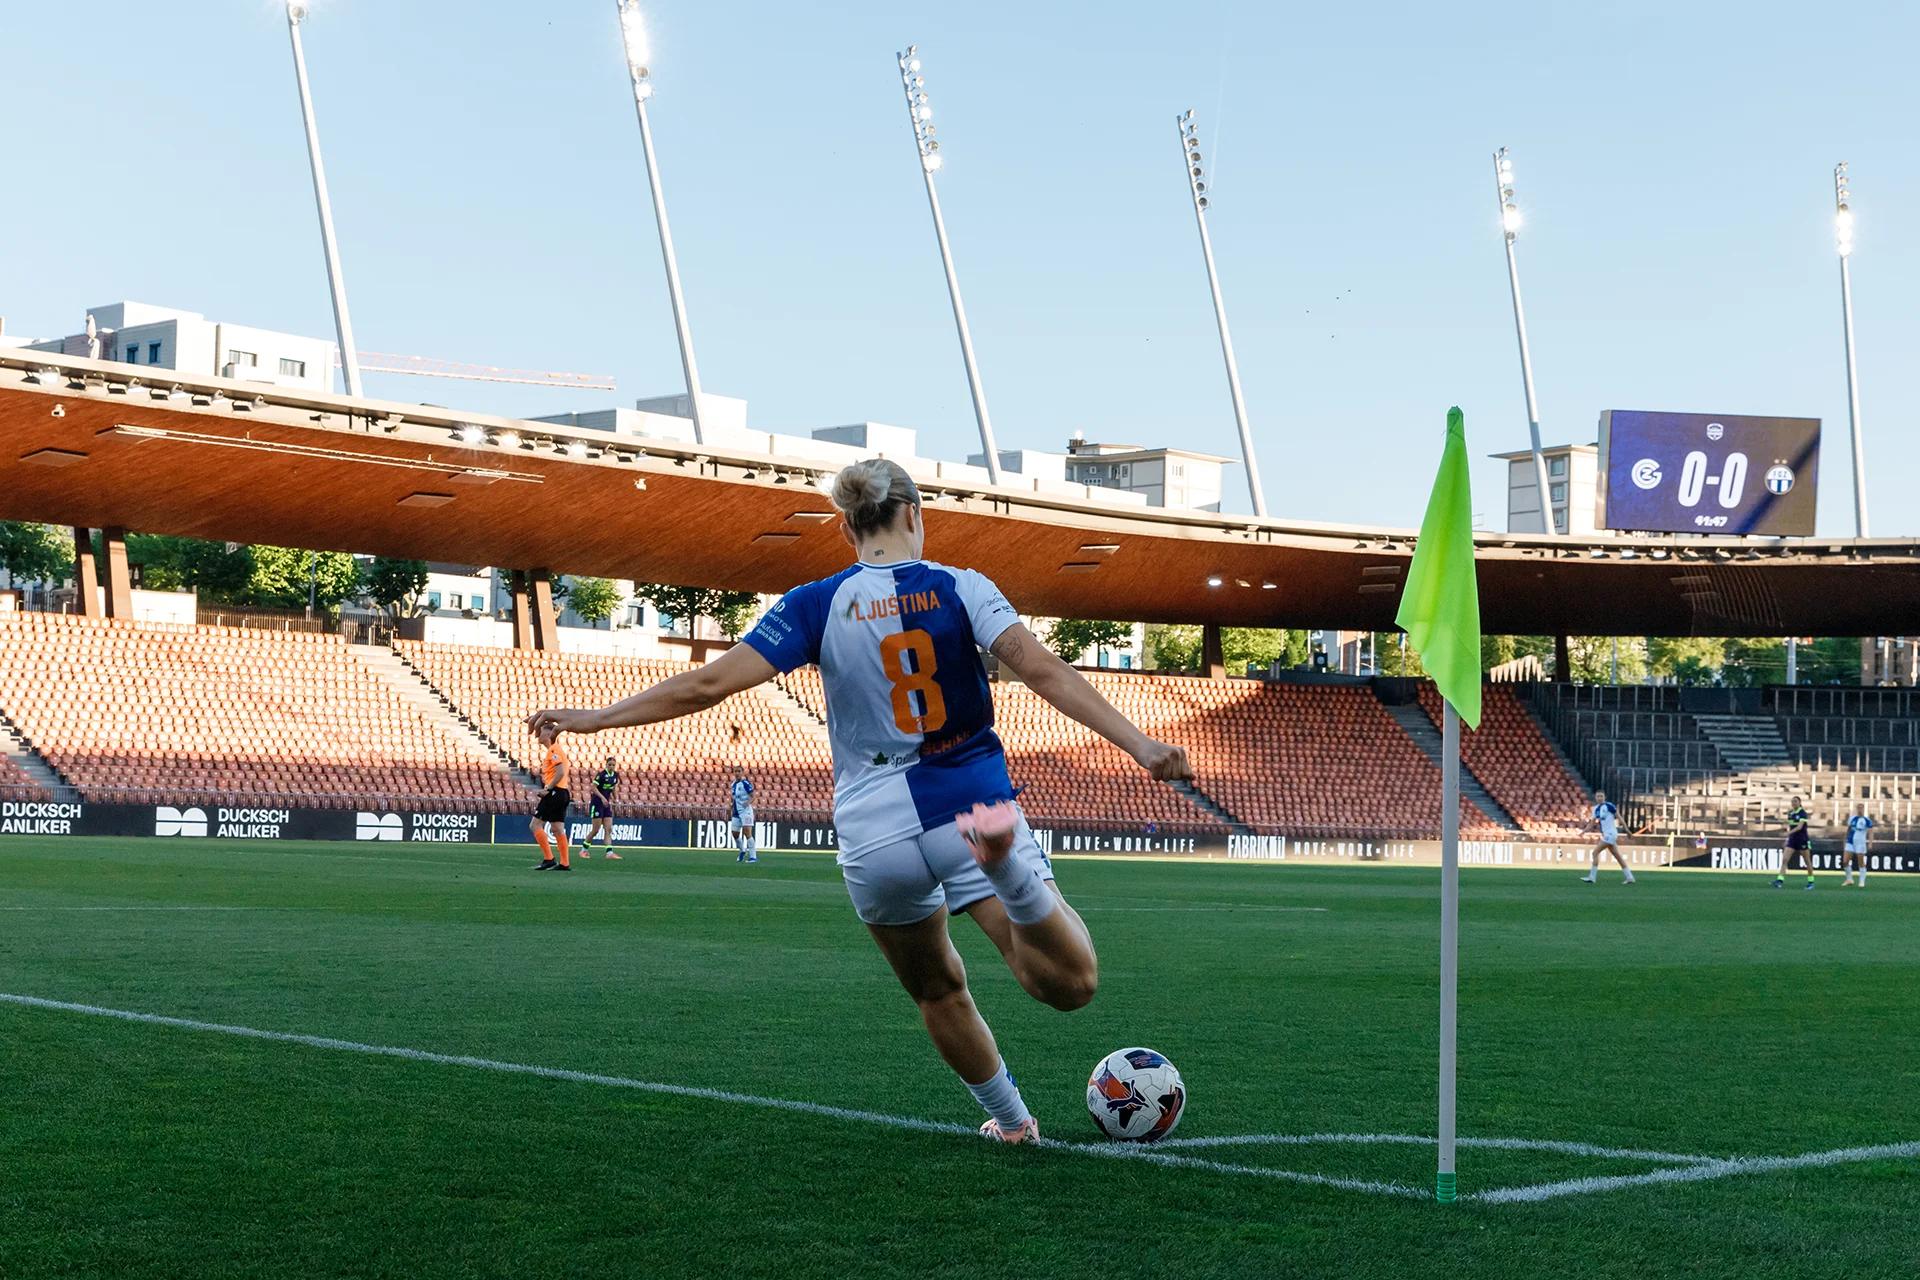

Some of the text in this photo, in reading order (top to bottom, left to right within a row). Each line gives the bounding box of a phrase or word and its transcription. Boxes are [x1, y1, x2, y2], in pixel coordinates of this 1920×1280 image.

[879, 629, 947, 734] 8
[2, 802, 81, 818] DUCKSCH
[218, 808, 289, 824] DUCKSCH
[1, 819, 71, 834] ANLIKER
[413, 813, 477, 828] DUCKSCH
[217, 824, 280, 839] ANLIKER
[412, 828, 469, 843] ANLIKER
[790, 828, 834, 846] MOVE
[1063, 835, 1100, 851] MOVE
[1113, 837, 1151, 852] WORK
[1164, 838, 1195, 853] LIFE
[1294, 841, 1327, 856] MOVE
[1337, 842, 1372, 857] WORK
[1384, 843, 1414, 858] LIFE
[1632, 850, 1667, 864] LIFE
[1864, 855, 1904, 870] ORK
